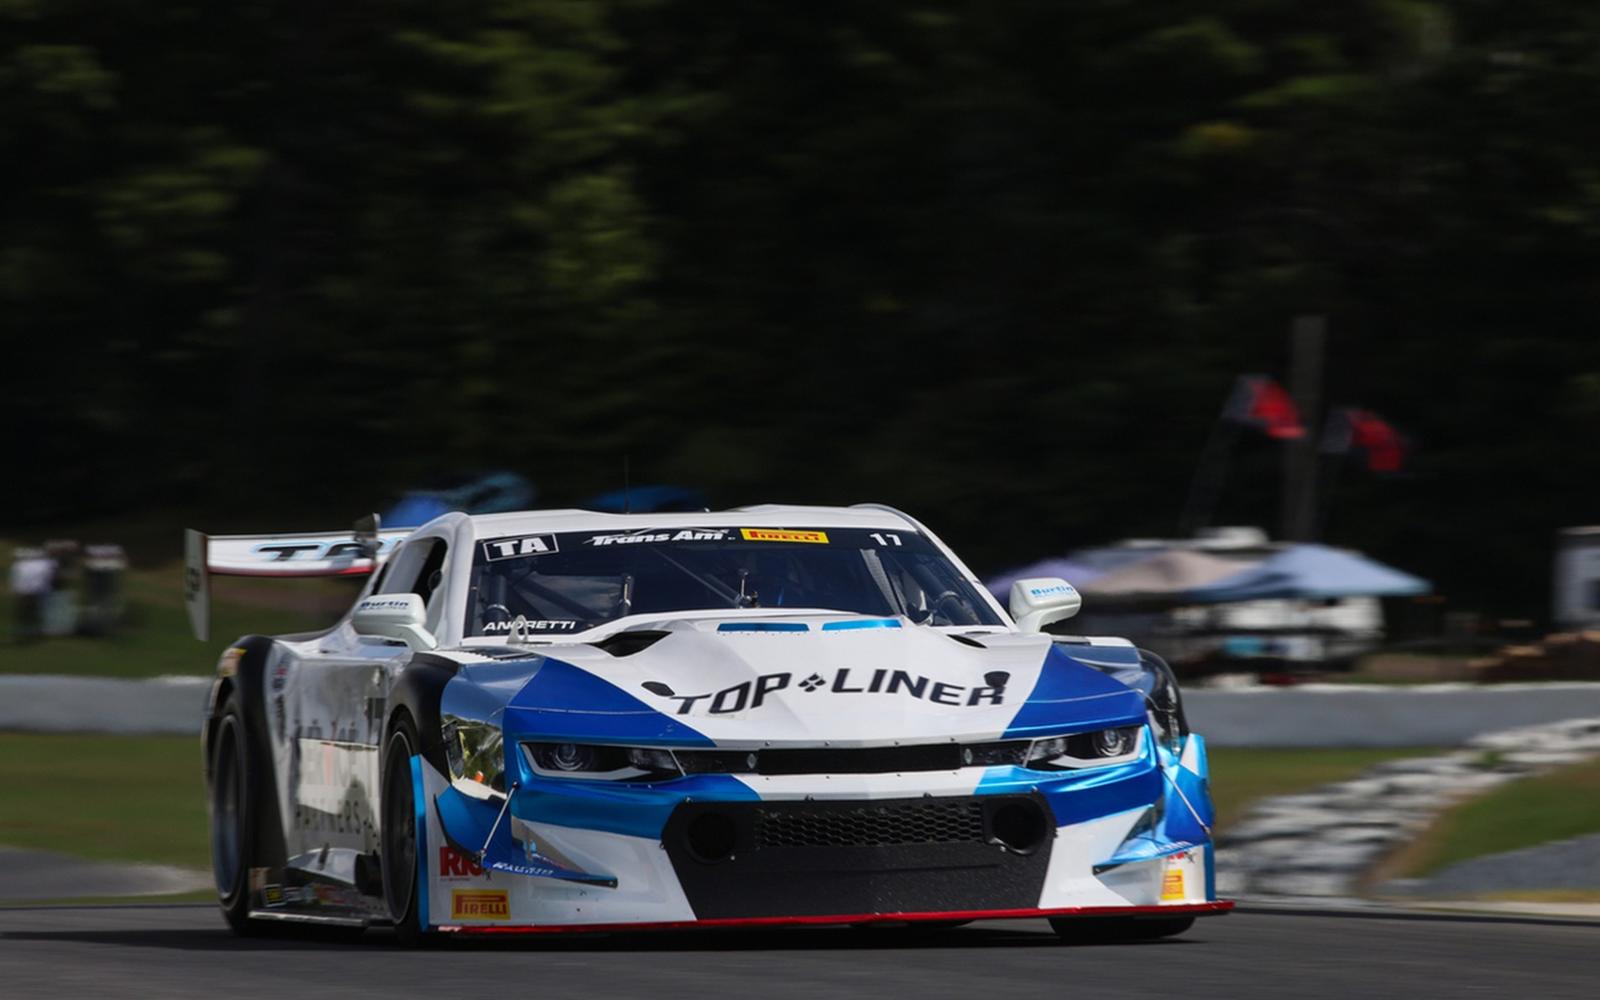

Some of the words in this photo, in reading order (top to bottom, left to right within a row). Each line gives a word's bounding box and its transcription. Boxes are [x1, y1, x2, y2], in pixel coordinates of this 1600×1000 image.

[590, 532, 670, 546] Trans
[671, 529, 724, 541] Am
[747, 529, 823, 542] PIRELLI
[493, 536, 549, 557] TA
[669, 672, 792, 715] TOP
[830, 668, 1006, 706] LINER
[455, 894, 507, 915] PIRELLI
